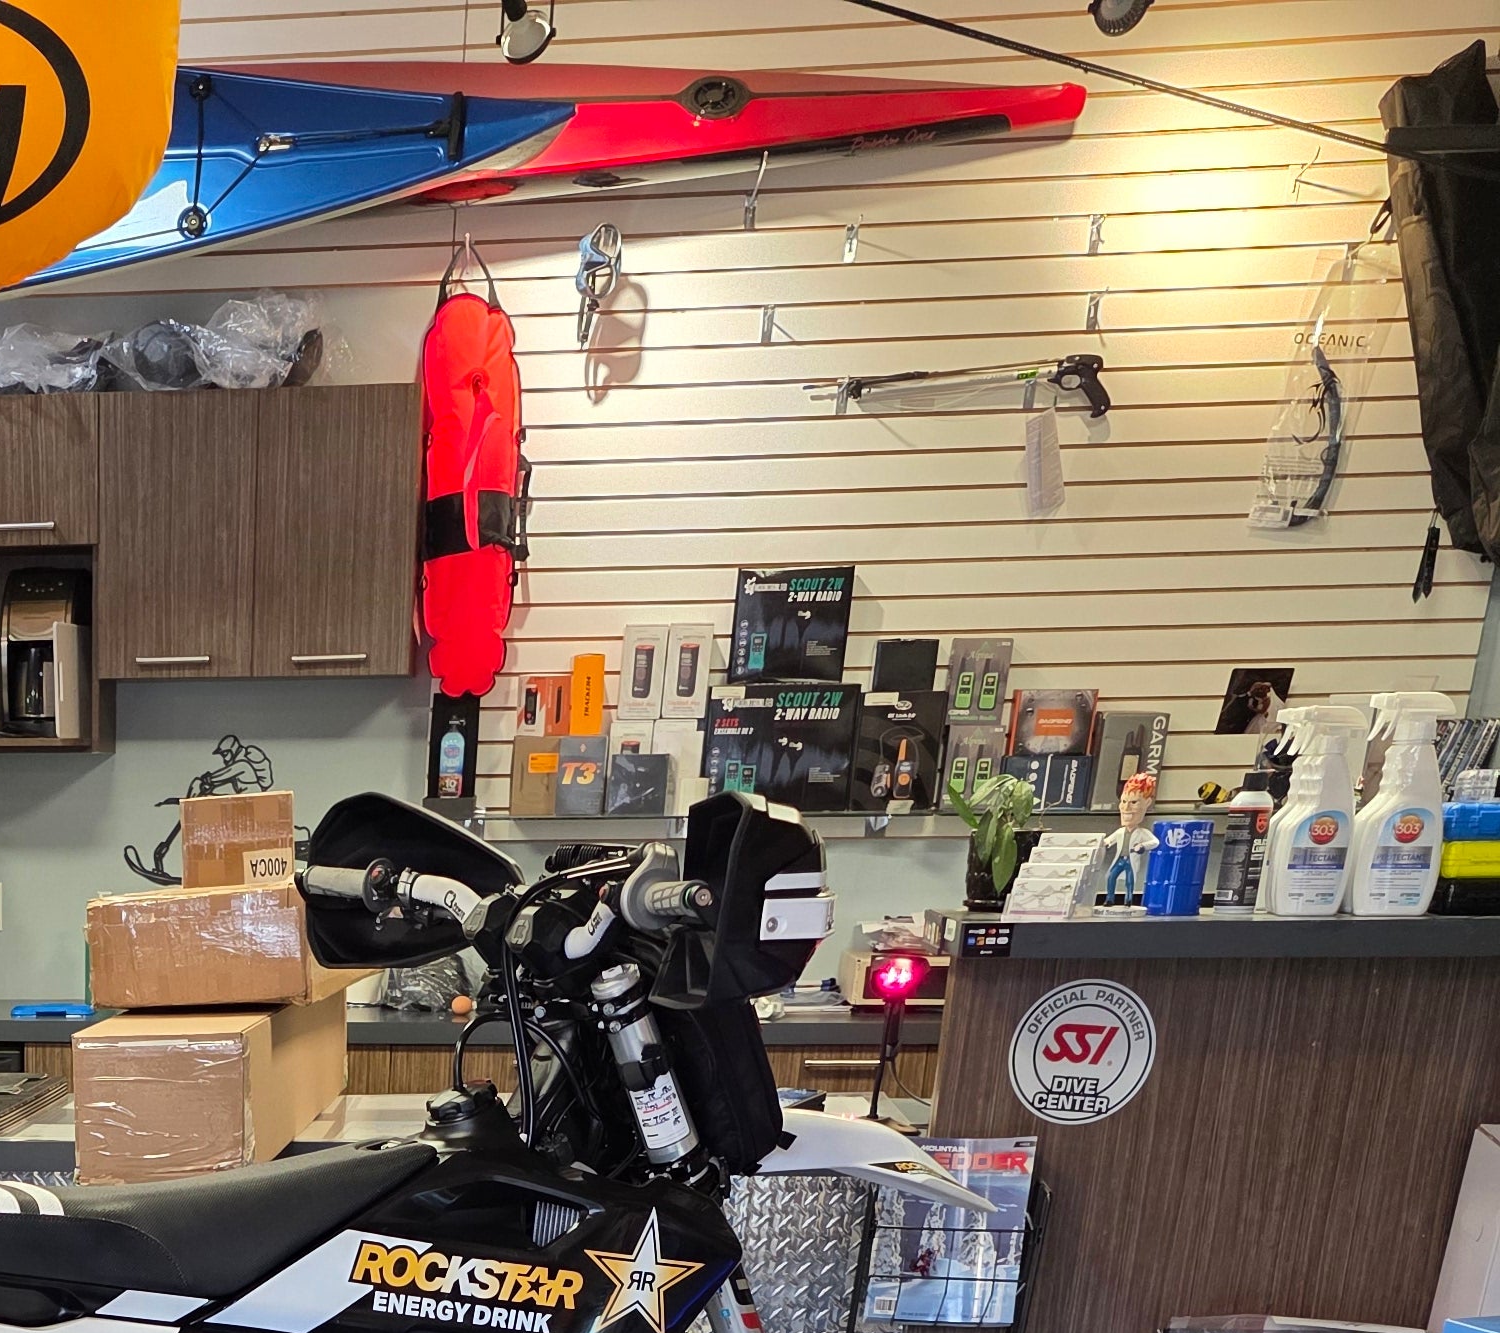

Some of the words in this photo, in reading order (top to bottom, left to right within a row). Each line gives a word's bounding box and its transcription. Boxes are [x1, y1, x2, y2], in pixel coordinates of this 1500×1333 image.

[1294, 333, 1365, 348] OCEANIC
[789, 578, 825, 591] SCOUT
[827, 578, 844, 590] 2W
[788, 591, 815, 602] 2-WAY
[815, 591, 842, 601] RADIO
[776, 692, 820, 708] SCOUT
[821, 692, 843, 707] 2W
[774, 708, 807, 720] 2-WAY
[808, 708, 840, 720] RADIO
[721, 718, 739, 727] SETS
[561, 762, 598, 785] T3
[1311, 822, 1335, 837] 303
[1395, 821, 1420, 836] 303
[250, 858, 287, 876] 400CA
[1028, 989, 1088, 1035] OFFICIAL
[1095, 989, 1146, 1042] PARTNER
[1042, 1023, 1120, 1065] SSI
[1052, 1077, 1098, 1094] DIVE
[1033, 1093, 1109, 1113] CENTER
[920, 1145, 968, 1153] MOUNTAIN
[352, 1241, 584, 1310] ROCKSTAR
[372, 1290, 472, 1324] ENERGY
[472, 1304, 553, 1333] DRINK
